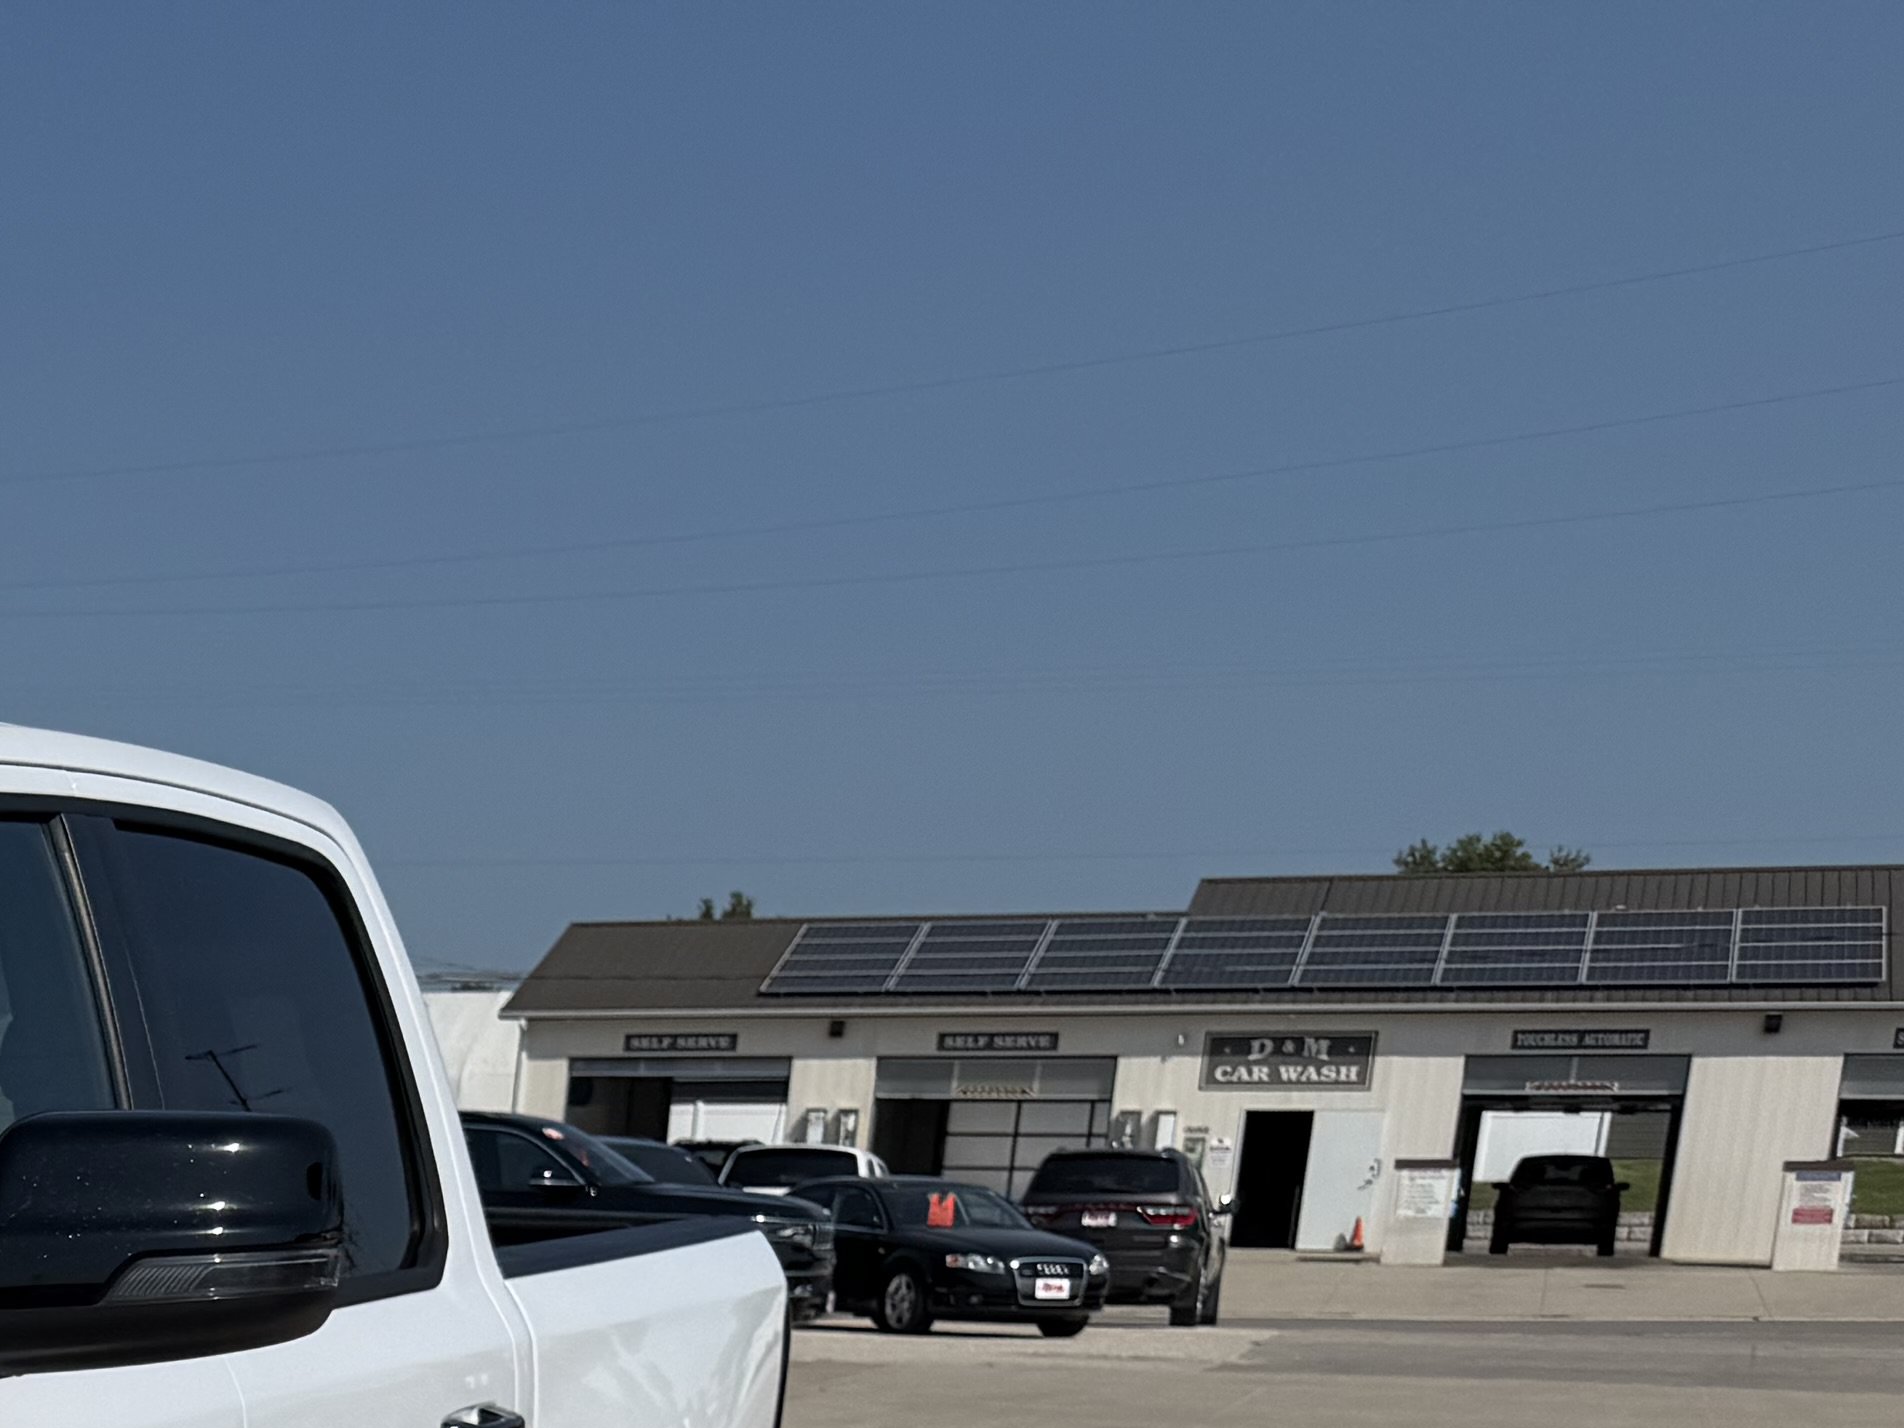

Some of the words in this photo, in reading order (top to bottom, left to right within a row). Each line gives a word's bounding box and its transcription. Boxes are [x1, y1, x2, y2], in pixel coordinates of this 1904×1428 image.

[629, 1036, 673, 1050] SELF
[676, 1035, 730, 1049] SERVE
[943, 1035, 989, 1049] SELF
[993, 1034, 1051, 1048] SERVE
[1248, 1037, 1274, 1061] D
[1281, 1039, 1296, 1053] &
[1302, 1037, 1332, 1061] M
[1214, 1064, 1270, 1082] CAR
[1278, 1064, 1361, 1082] WASH
